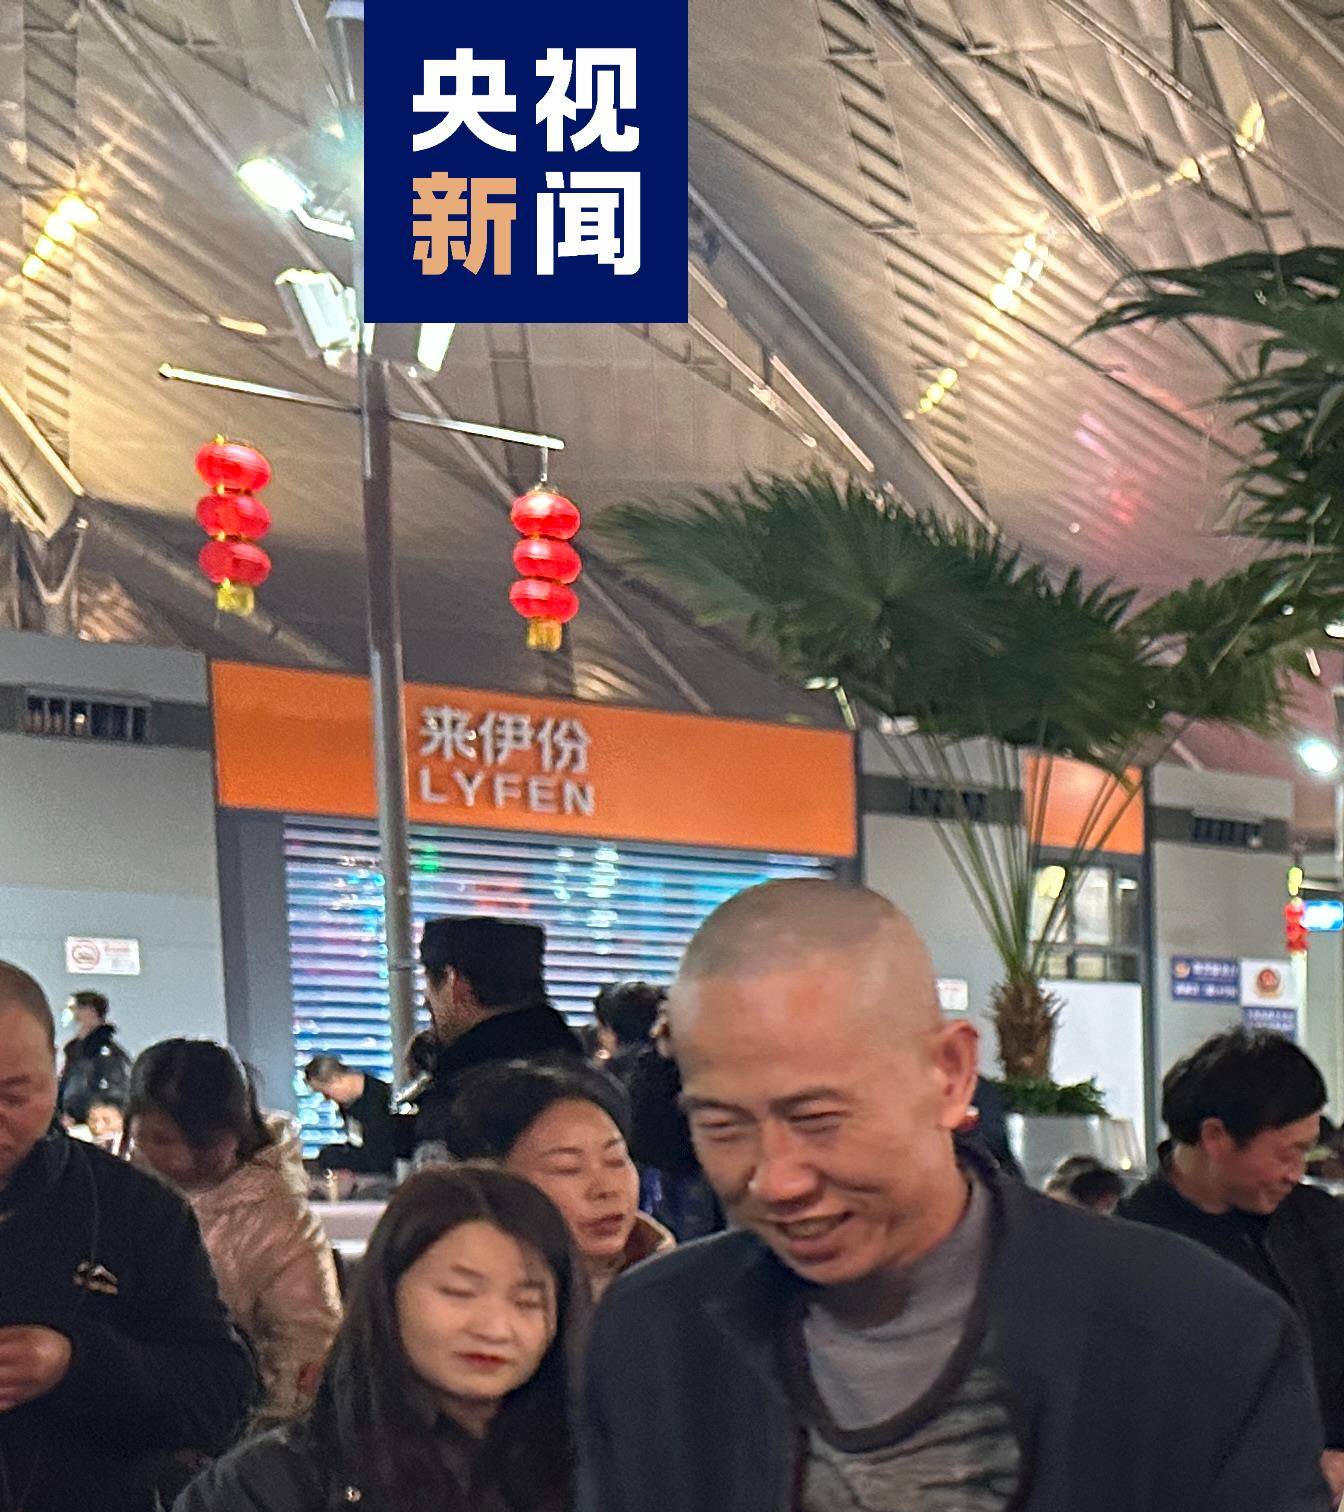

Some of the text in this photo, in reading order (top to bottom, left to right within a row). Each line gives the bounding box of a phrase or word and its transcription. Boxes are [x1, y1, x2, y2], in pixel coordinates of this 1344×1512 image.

[418, 704, 593, 775] 来伊份
[418, 764, 596, 817] LYFEN
